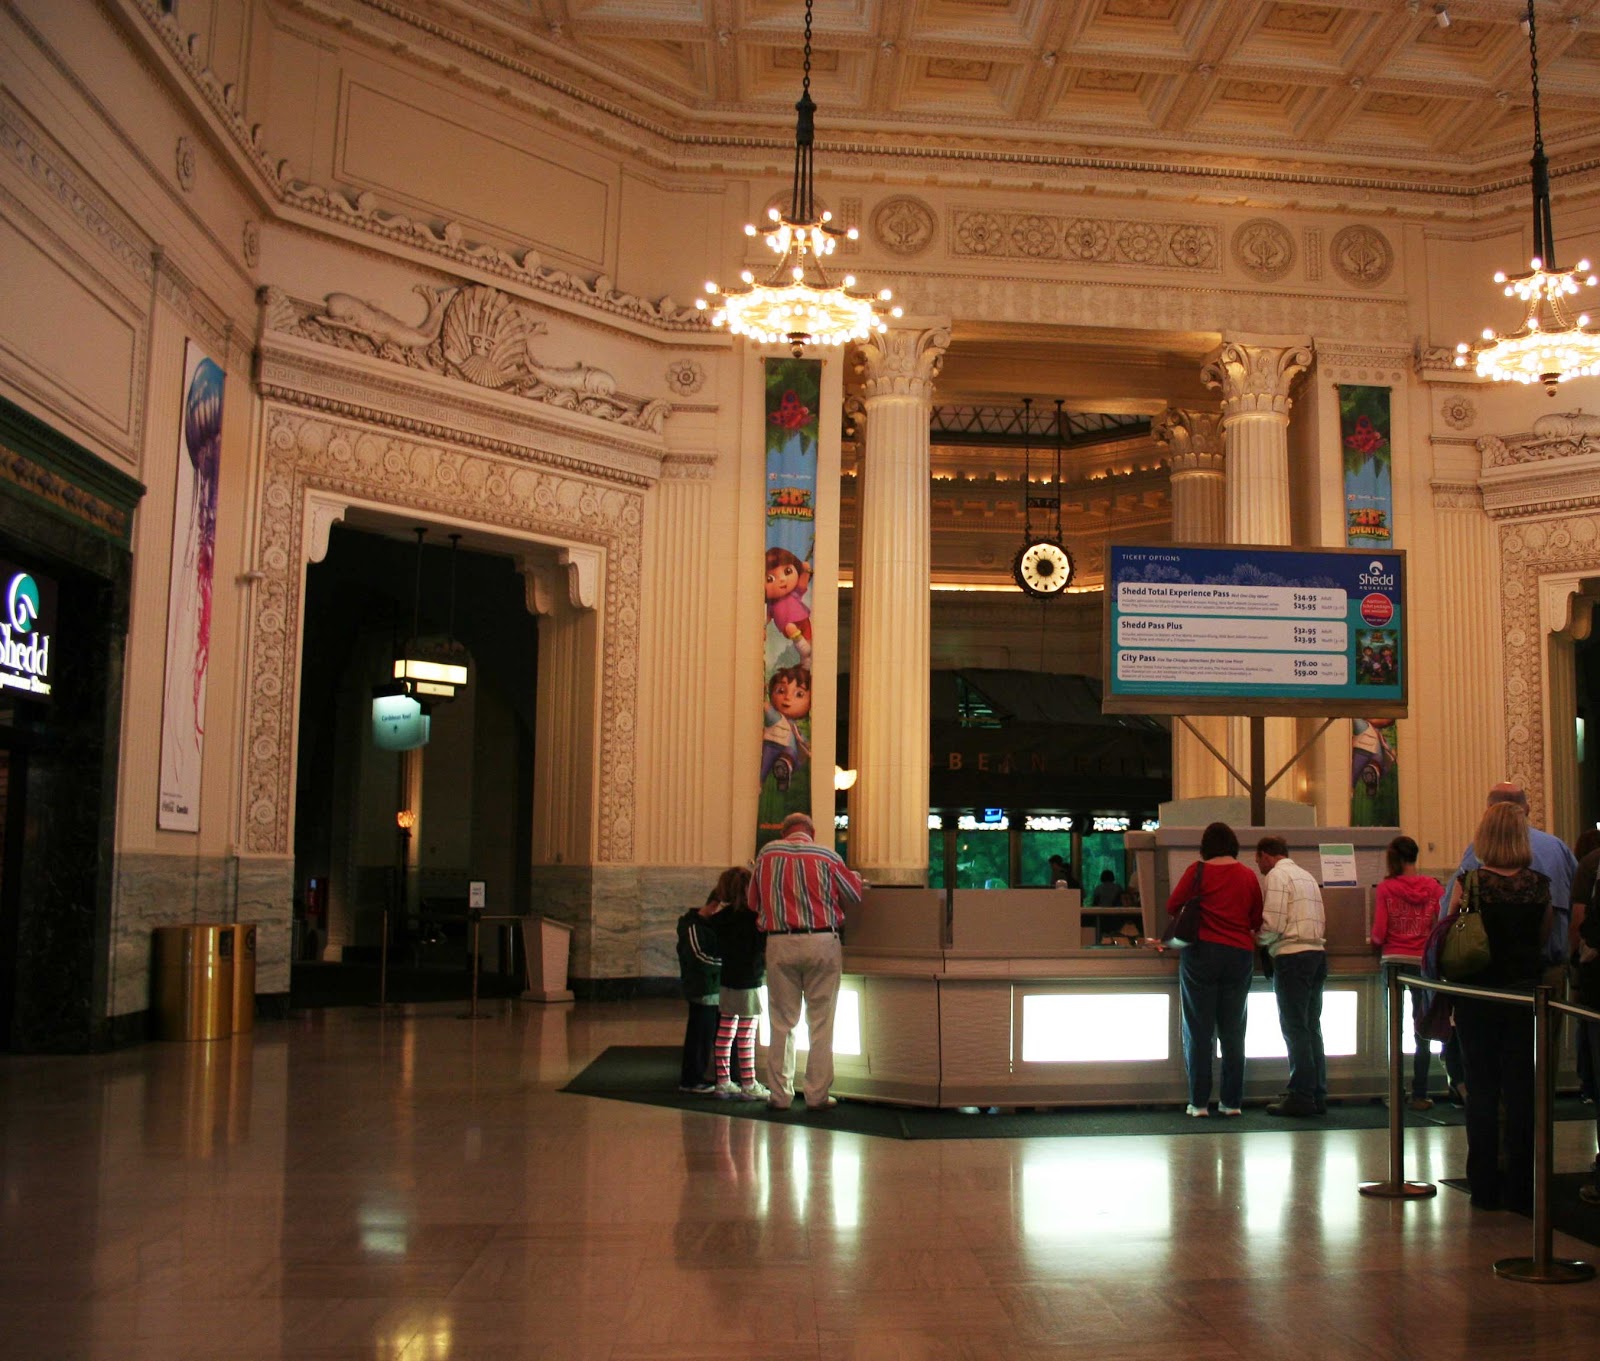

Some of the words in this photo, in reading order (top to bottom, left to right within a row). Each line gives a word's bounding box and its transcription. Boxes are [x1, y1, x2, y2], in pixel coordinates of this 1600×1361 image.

[1359, 573, 1394, 586] Shedd
[1122, 588, 1147, 596] Shedd
[1148, 588, 1168, 597] Total
[1169, 590, 1211, 599] Experience
[1294, 593, 1317, 602] $34.95
[1294, 602, 1316, 611] $25.95
[1122, 621, 1146, 629] Shedd
[1167, 622, 1183, 630] Plus
[1294, 627, 1316, 635] $32.95
[1294, 636, 1316, 644] $23.95
[1121, 654, 1136, 663] City
[1294, 660, 1318, 669] $76.00
[1294, 669, 1318, 678] $59.00
